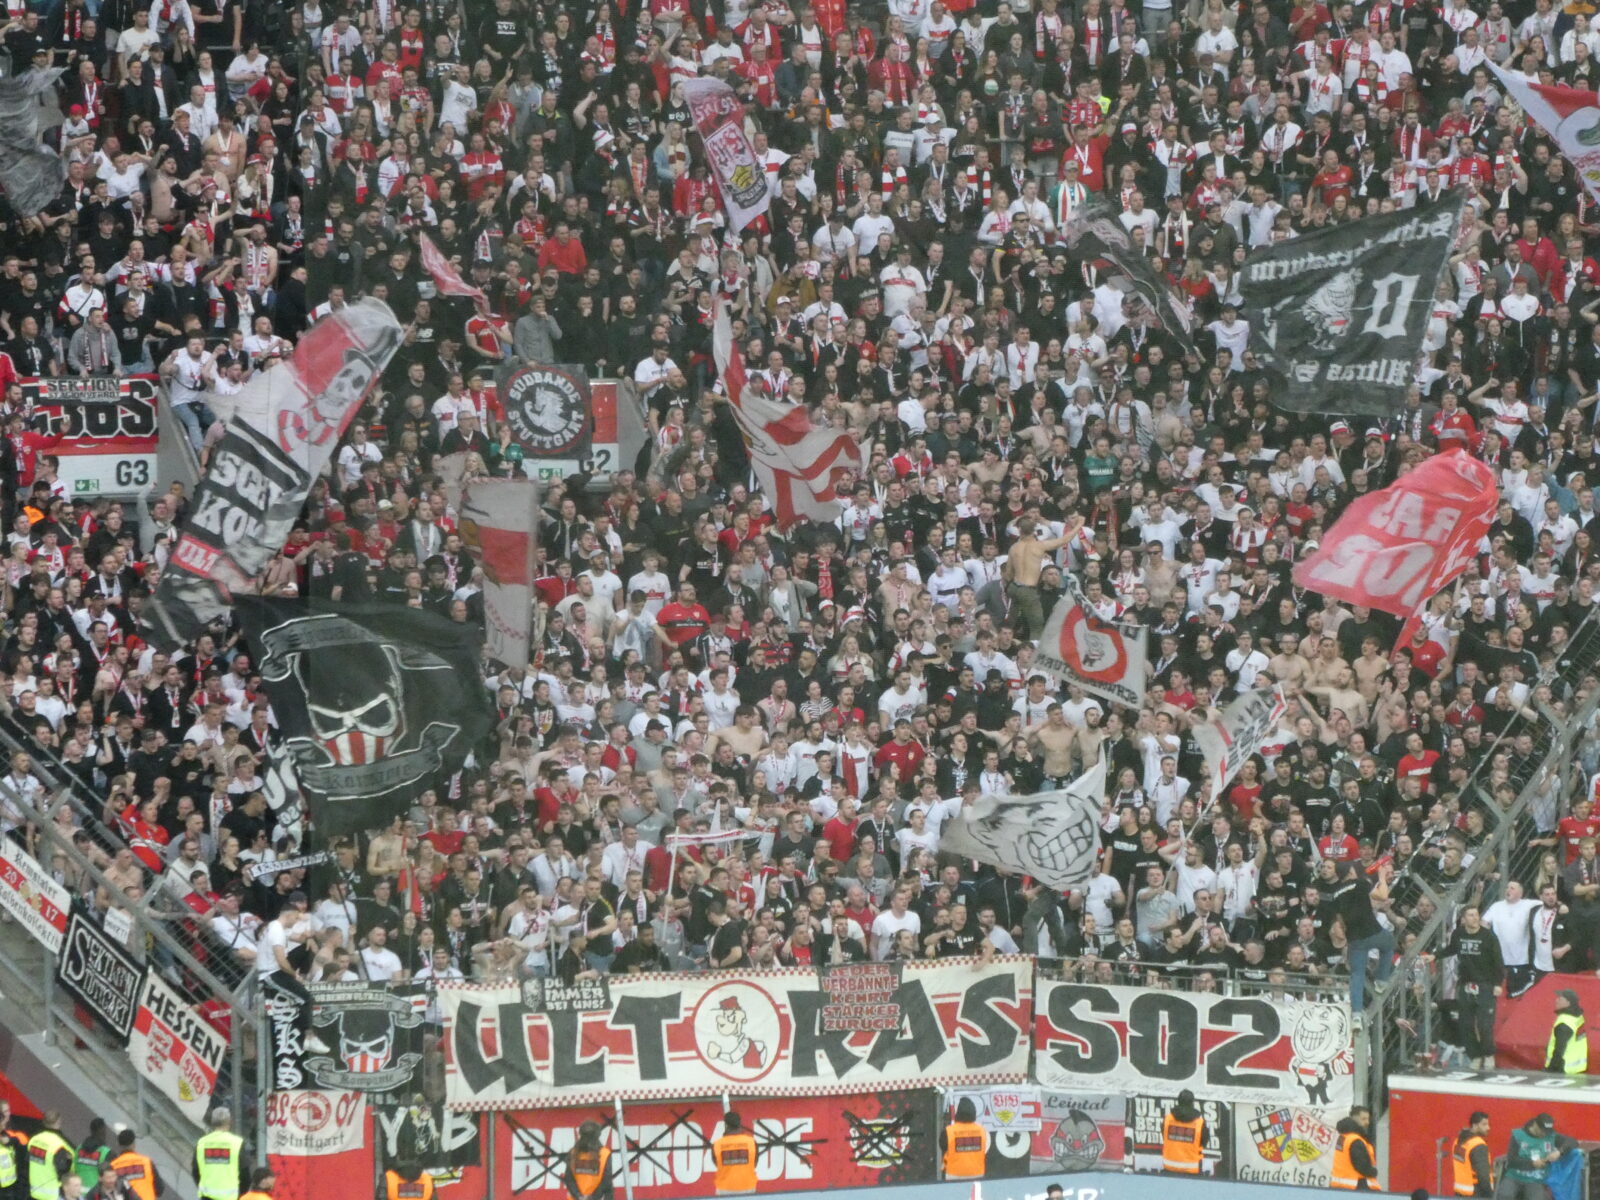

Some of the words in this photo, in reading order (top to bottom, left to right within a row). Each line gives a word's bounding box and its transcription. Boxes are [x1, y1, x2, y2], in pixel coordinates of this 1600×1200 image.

[47, 378, 120, 392] SEKTION
[508, 410, 585, 449] STUTTGART
[116, 460, 149, 486] G3
[829, 964, 890, 978] JEDER
[821, 973, 900, 992] VERBANNTE
[544, 988, 605, 1001] IMMER
[830, 991, 893, 1004] KEHRT
[546, 1001, 567, 1011] BEI
[572, 998, 606, 1010] UNS!
[145, 981, 222, 1069] HESSEN
[1045, 1096, 1110, 1112] Leintal
[273, 1129, 345, 1151] Stuttgart
[1239, 1163, 1330, 1187] Gundelshe
